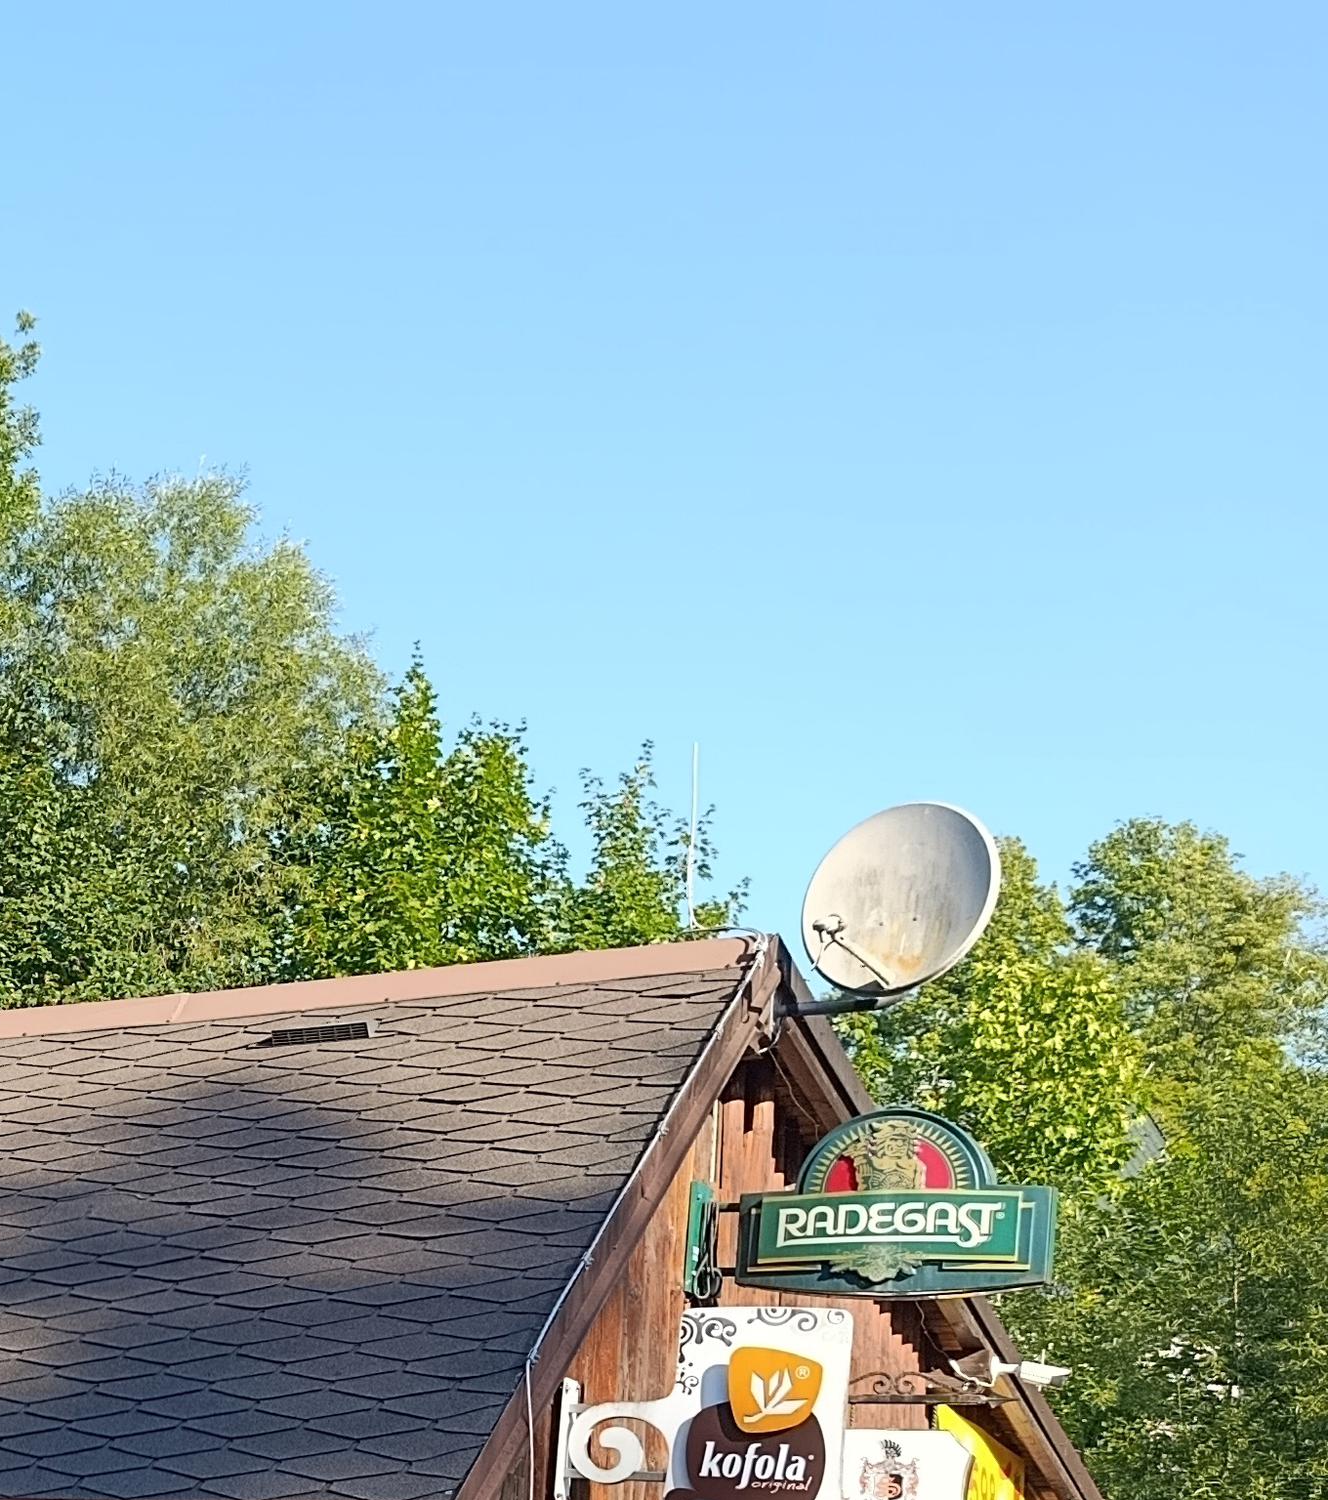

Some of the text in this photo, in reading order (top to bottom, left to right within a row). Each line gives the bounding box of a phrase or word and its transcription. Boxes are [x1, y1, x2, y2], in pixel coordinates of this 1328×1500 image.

[776, 1201, 1002, 1248] RADEGAST
[698, 1441, 806, 1490] kofola
[751, 1478, 811, 1495] original
